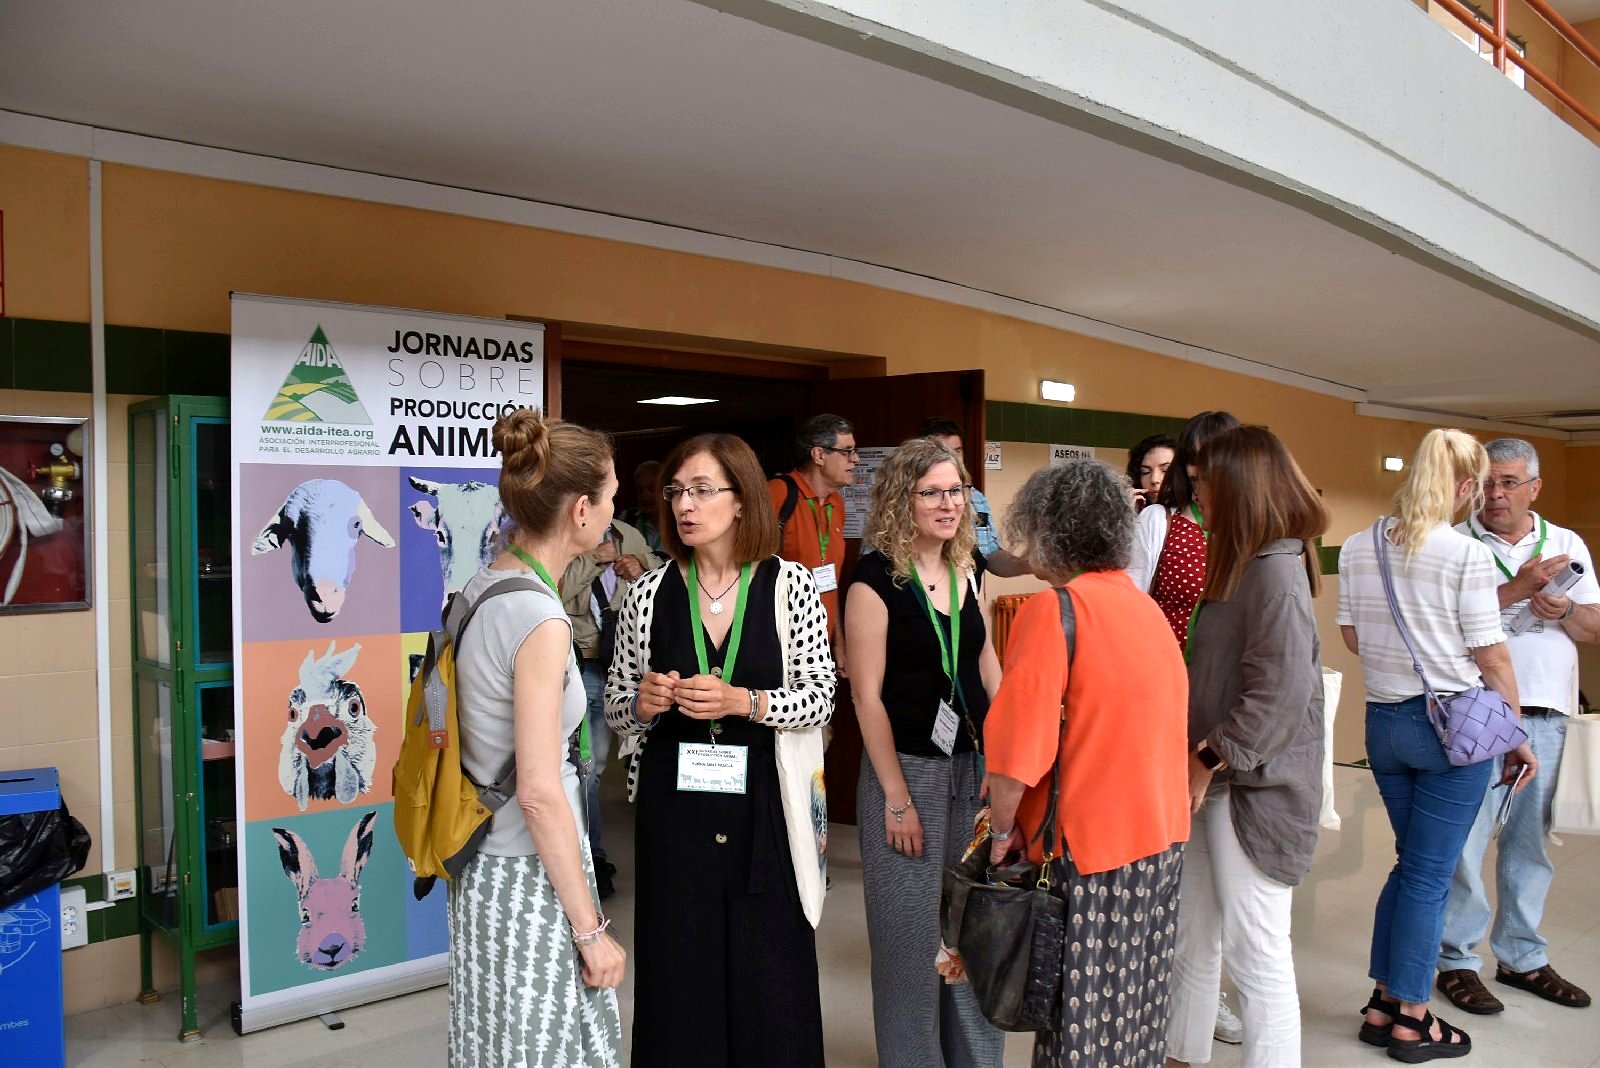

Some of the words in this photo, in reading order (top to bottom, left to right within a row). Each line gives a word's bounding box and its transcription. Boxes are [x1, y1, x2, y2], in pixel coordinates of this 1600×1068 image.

[295, 342, 343, 369] AIDA
[387, 330, 534, 363] JORNADAS
[388, 358, 533, 395] SOBRE
[390, 397, 533, 421] PRODUCCIÓ
[259, 437, 306, 445] ASOCIACIÓN
[308, 439, 380, 448] INTERPROFESIONAL
[261, 425, 374, 440] www.aida-itea.org
[388, 424, 501, 458] ANIM
[295, 447, 345, 455] DESARROLLO
[1054, 449, 1080, 459] ASEOS
